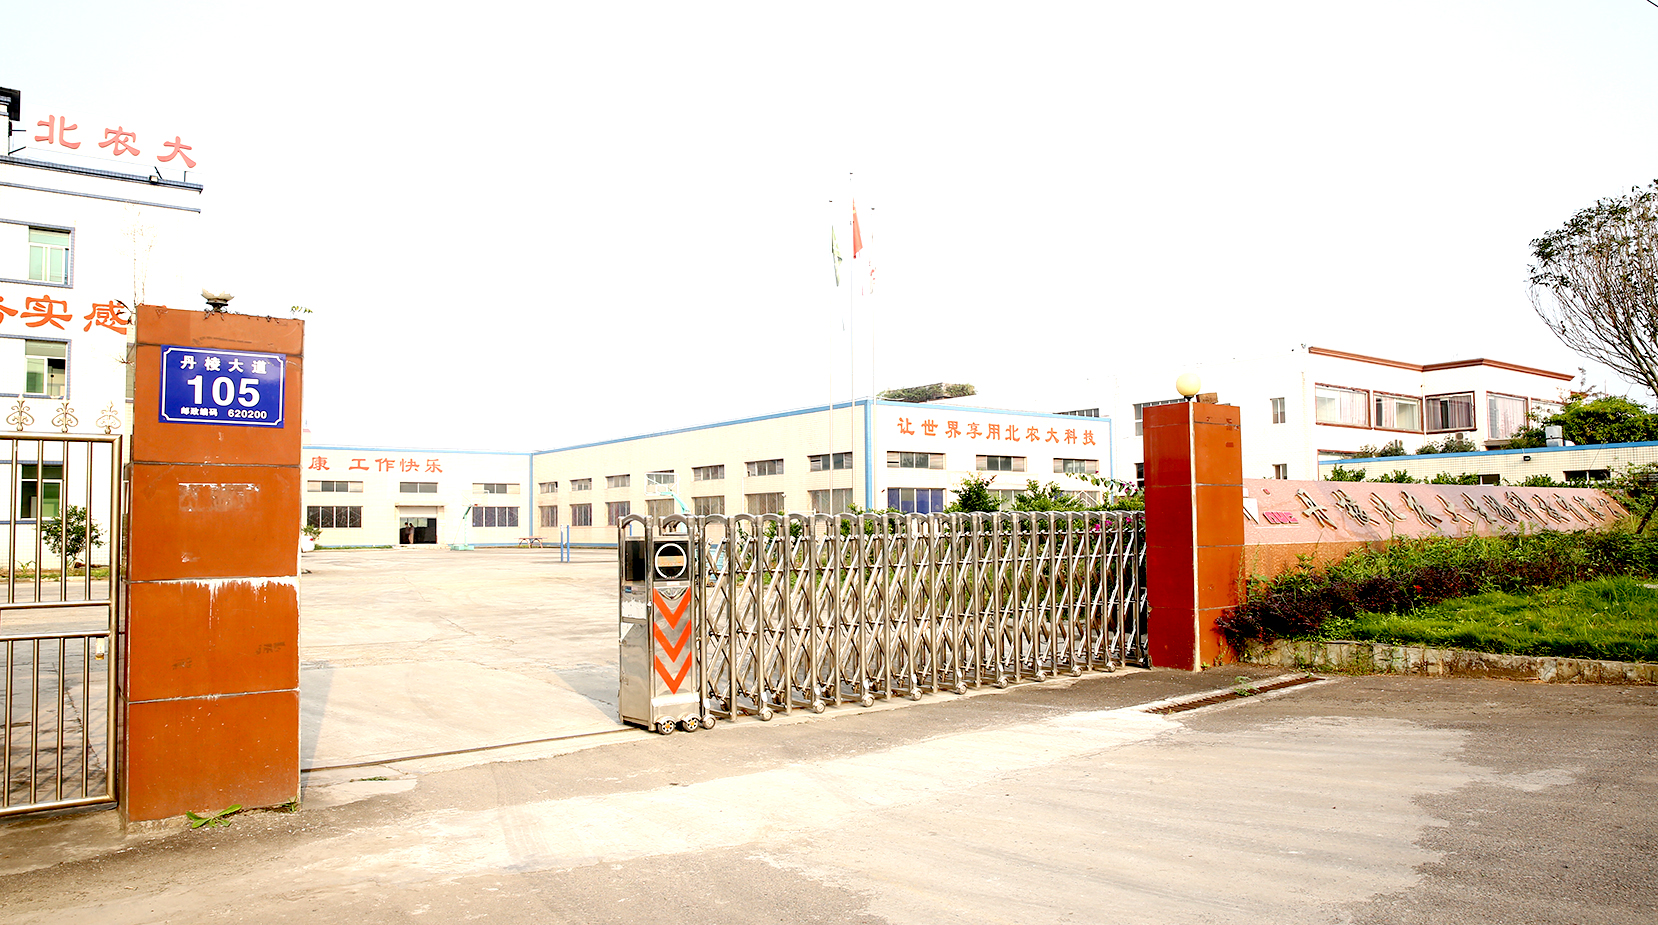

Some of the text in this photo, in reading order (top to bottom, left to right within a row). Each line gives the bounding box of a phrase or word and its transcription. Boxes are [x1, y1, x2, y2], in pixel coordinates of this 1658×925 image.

[34, 114, 197, 169] 北农大
[180, 355, 267, 375] 丹棱大道
[187, 375, 261, 408] 105
[180, 407, 268, 420] 邮政编码 620200
[897, 417, 1097, 446] 让世界享用北农大科技
[308, 456, 443, 473] 康 工作快乐
[1295, 488, 1630, 531] 丹棱北农大生物科技有限公
